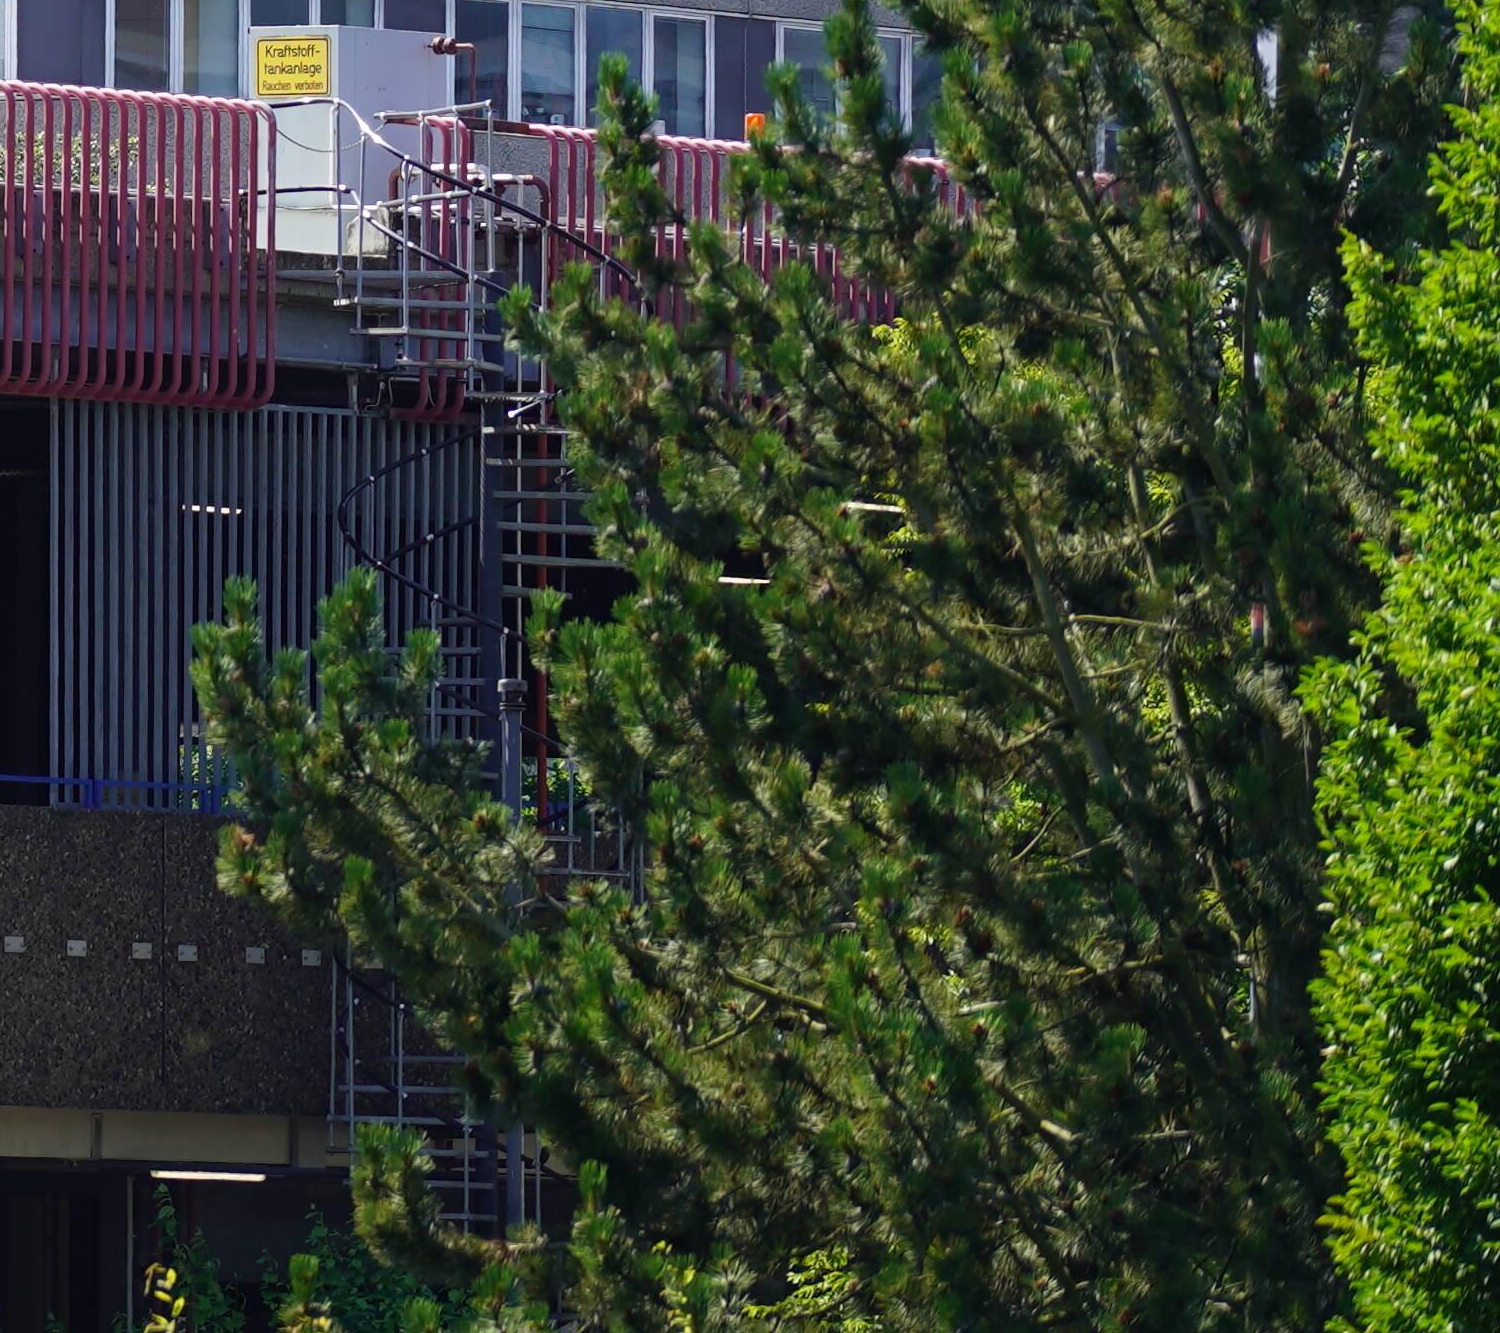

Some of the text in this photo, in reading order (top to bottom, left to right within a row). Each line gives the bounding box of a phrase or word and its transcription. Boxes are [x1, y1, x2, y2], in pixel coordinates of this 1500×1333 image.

[265, 44, 321, 58] Kraftstoff-
[264, 61, 322, 77] tankanlage
[263, 80, 323, 91] Rauchen verboten
